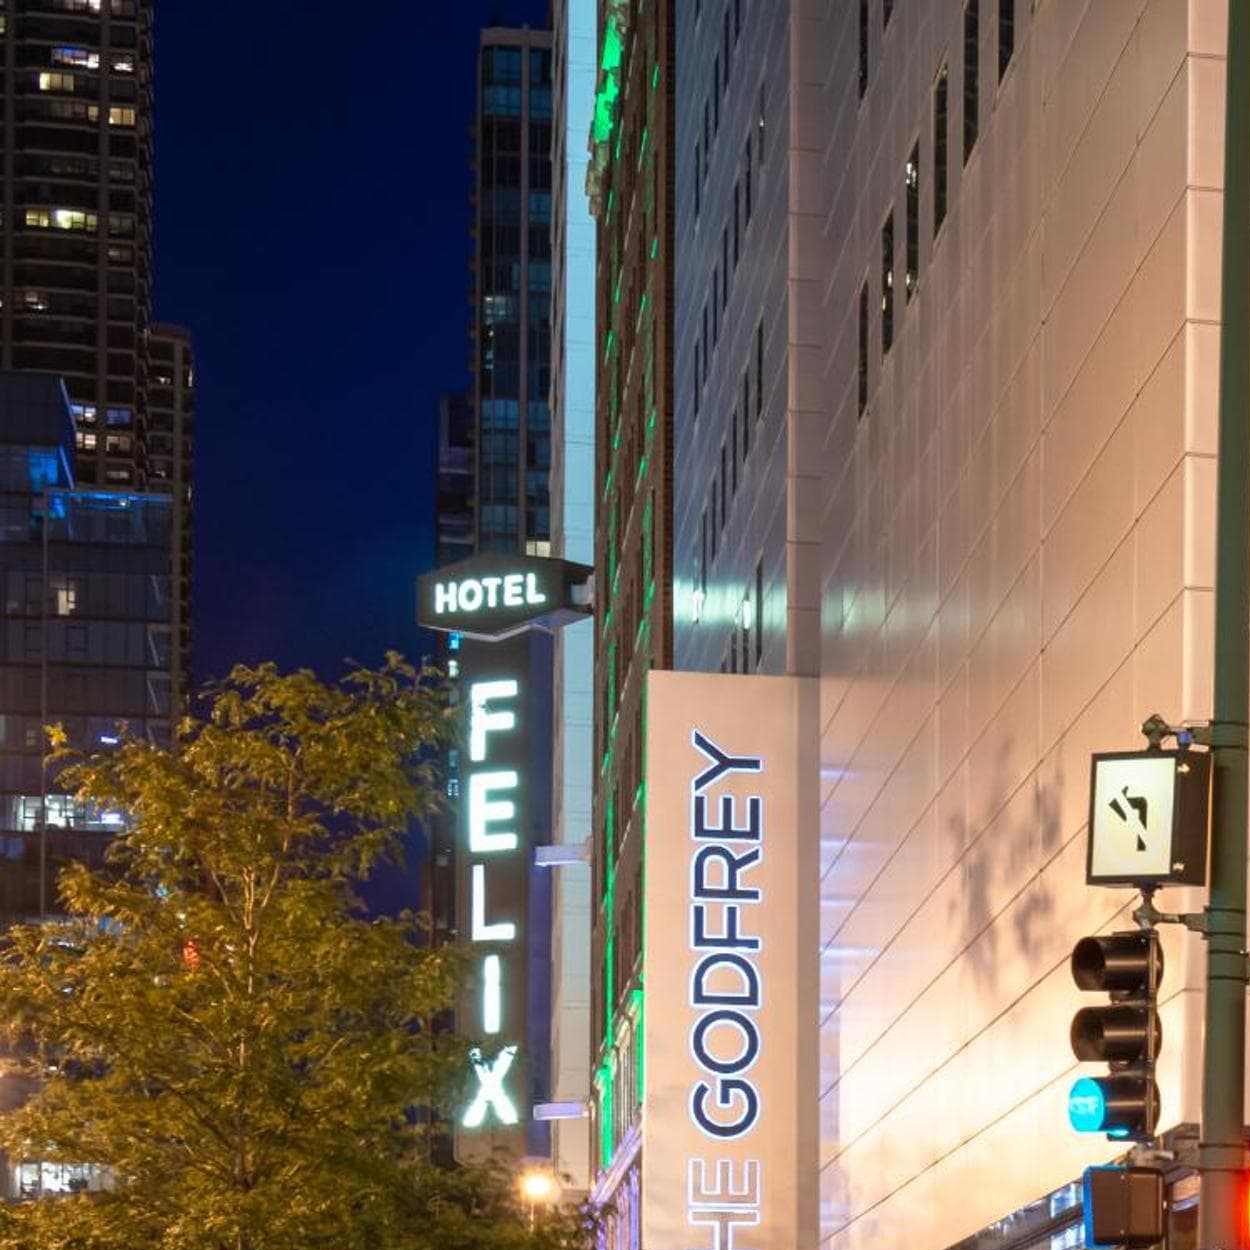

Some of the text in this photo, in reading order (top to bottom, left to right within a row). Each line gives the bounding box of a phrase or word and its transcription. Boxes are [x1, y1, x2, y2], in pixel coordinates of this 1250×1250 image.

[434, 572, 547, 614] HOTEL
[463, 679, 518, 1128] FELIX
[690, 729, 763, 1140] GODFREY
